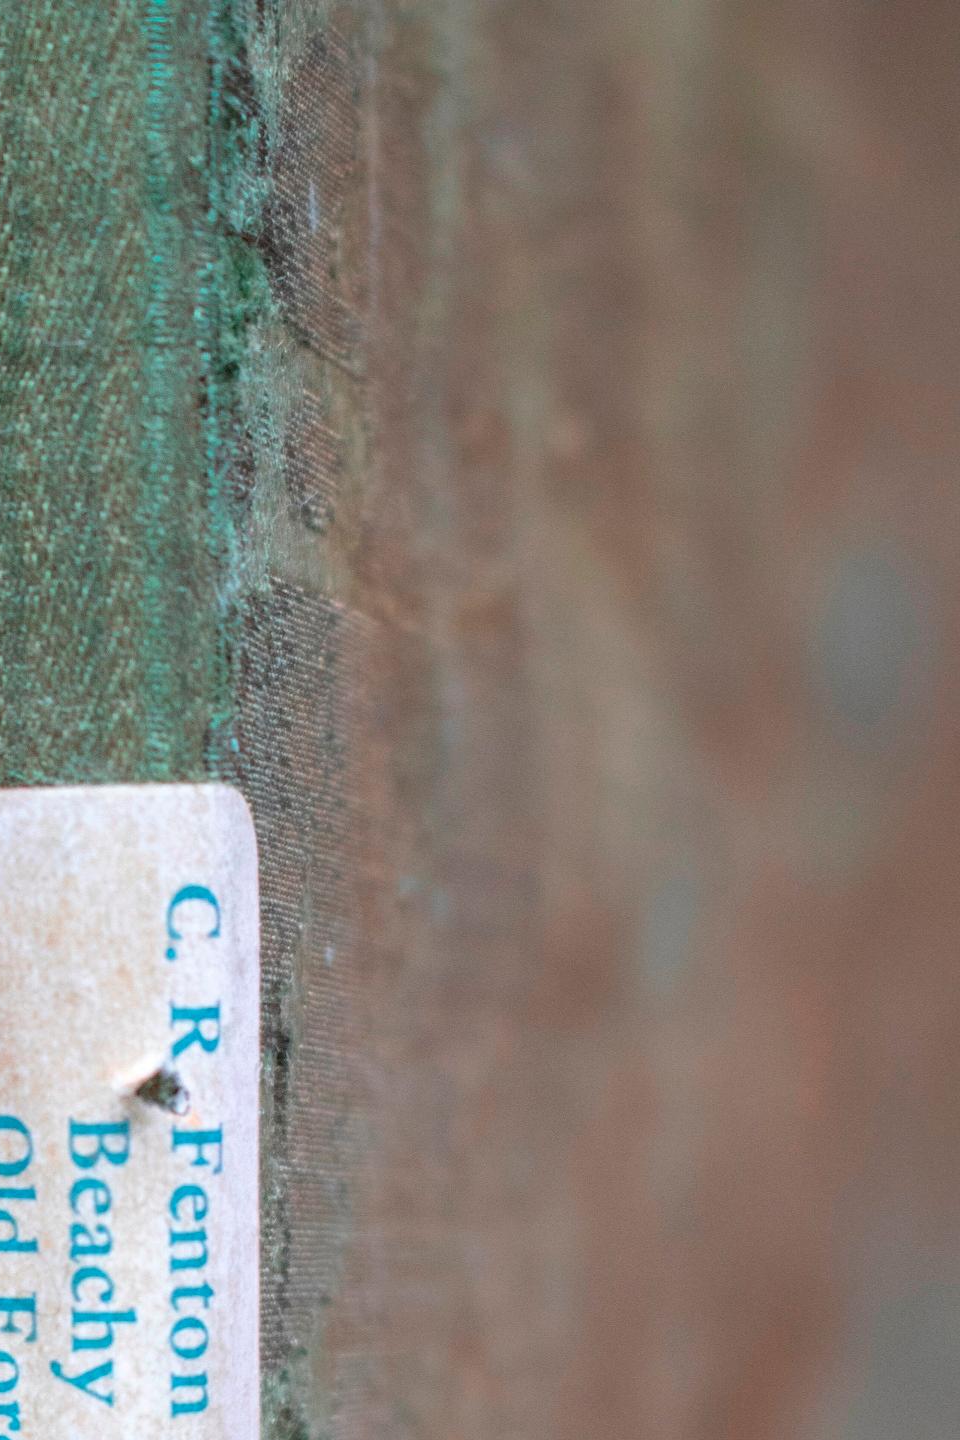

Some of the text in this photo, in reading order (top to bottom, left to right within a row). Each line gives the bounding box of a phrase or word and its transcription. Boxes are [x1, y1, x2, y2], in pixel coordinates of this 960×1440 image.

[165, 883, 222, 962] C.
[49, 1117, 138, 1408] Beachy
[167, 1123, 224, 1419] Fenton
